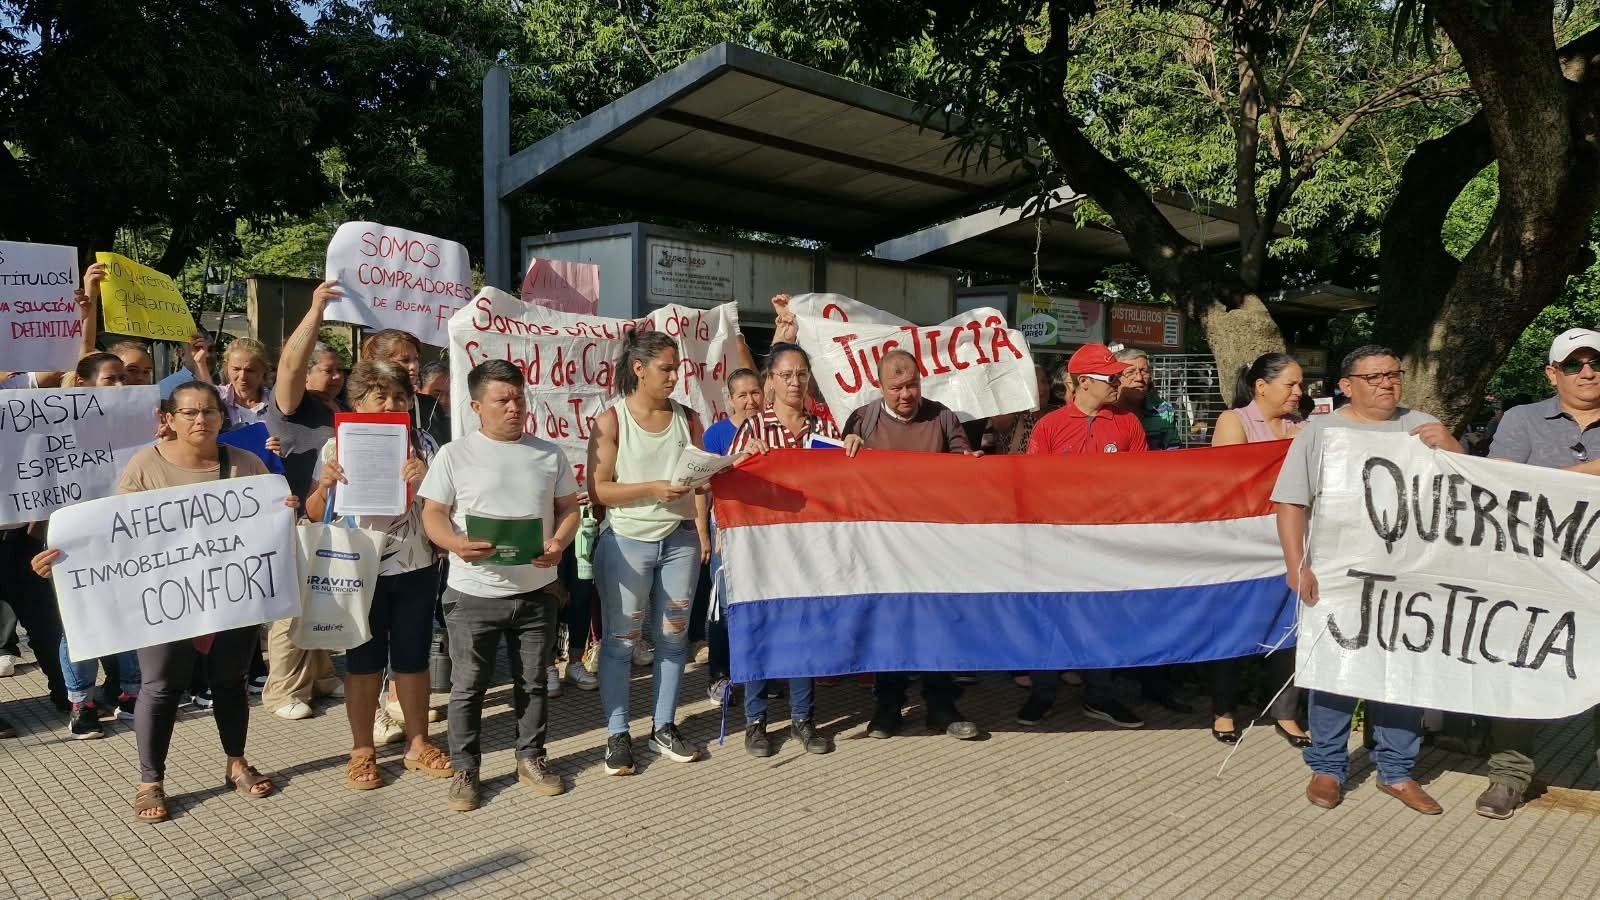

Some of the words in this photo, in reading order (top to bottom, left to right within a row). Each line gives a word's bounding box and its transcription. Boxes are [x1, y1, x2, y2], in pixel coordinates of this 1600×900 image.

[360, 232, 441, 268] SOMOS
[358, 263, 474, 300] COMPRADORES
[14, 297, 76, 314] SOLUCIÓN
[373, 296, 388, 308] DE
[395, 300, 432, 314] BUENA
[472, 297, 559, 336] Somos
[665, 307, 689, 337] de
[695, 310, 709, 341] la
[1111, 307, 1162, 323] DISTRILIBROS
[1021, 322, 1044, 332] practi
[1123, 323, 1144, 334] LOCAL
[550, 346, 577, 387] de
[712, 353, 727, 382] el
[833, 319, 1024, 394] JUTICIA
[546, 400, 569, 438] de
[46, 434, 76, 453] DE
[9, 482, 82, 512] TERRENO
[111, 487, 260, 543] AFECTADOS
[68, 534, 245, 590] INMOBILIARIA
[142, 551, 277, 626] CONFORT
[1327, 569, 1577, 680] JUSTICIA
